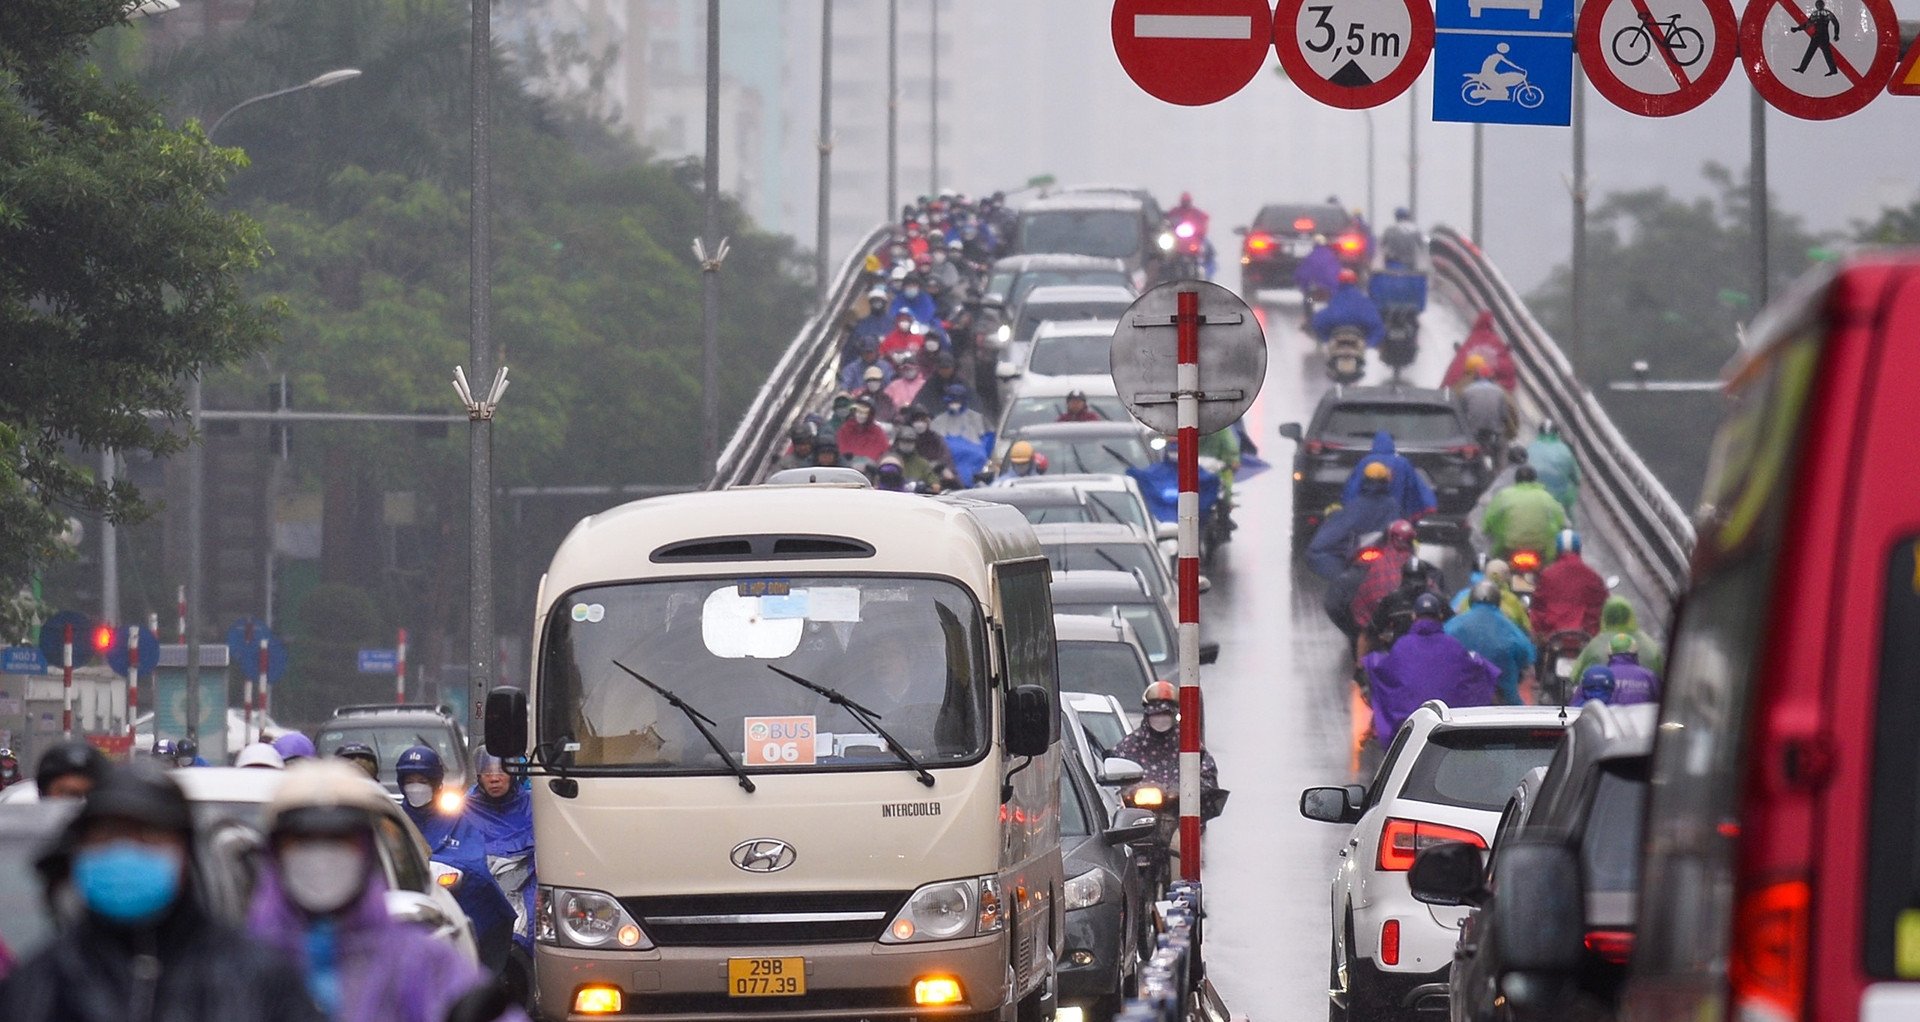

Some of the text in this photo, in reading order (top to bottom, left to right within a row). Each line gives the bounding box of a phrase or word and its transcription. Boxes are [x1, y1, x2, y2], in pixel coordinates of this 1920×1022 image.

[770, 722, 811, 739] BUS
[762, 742, 799, 763] 06
[882, 802, 941, 817] INTERCOOLER
[750, 959, 783, 976] 29B
[737, 977, 797, 994] 077.39
